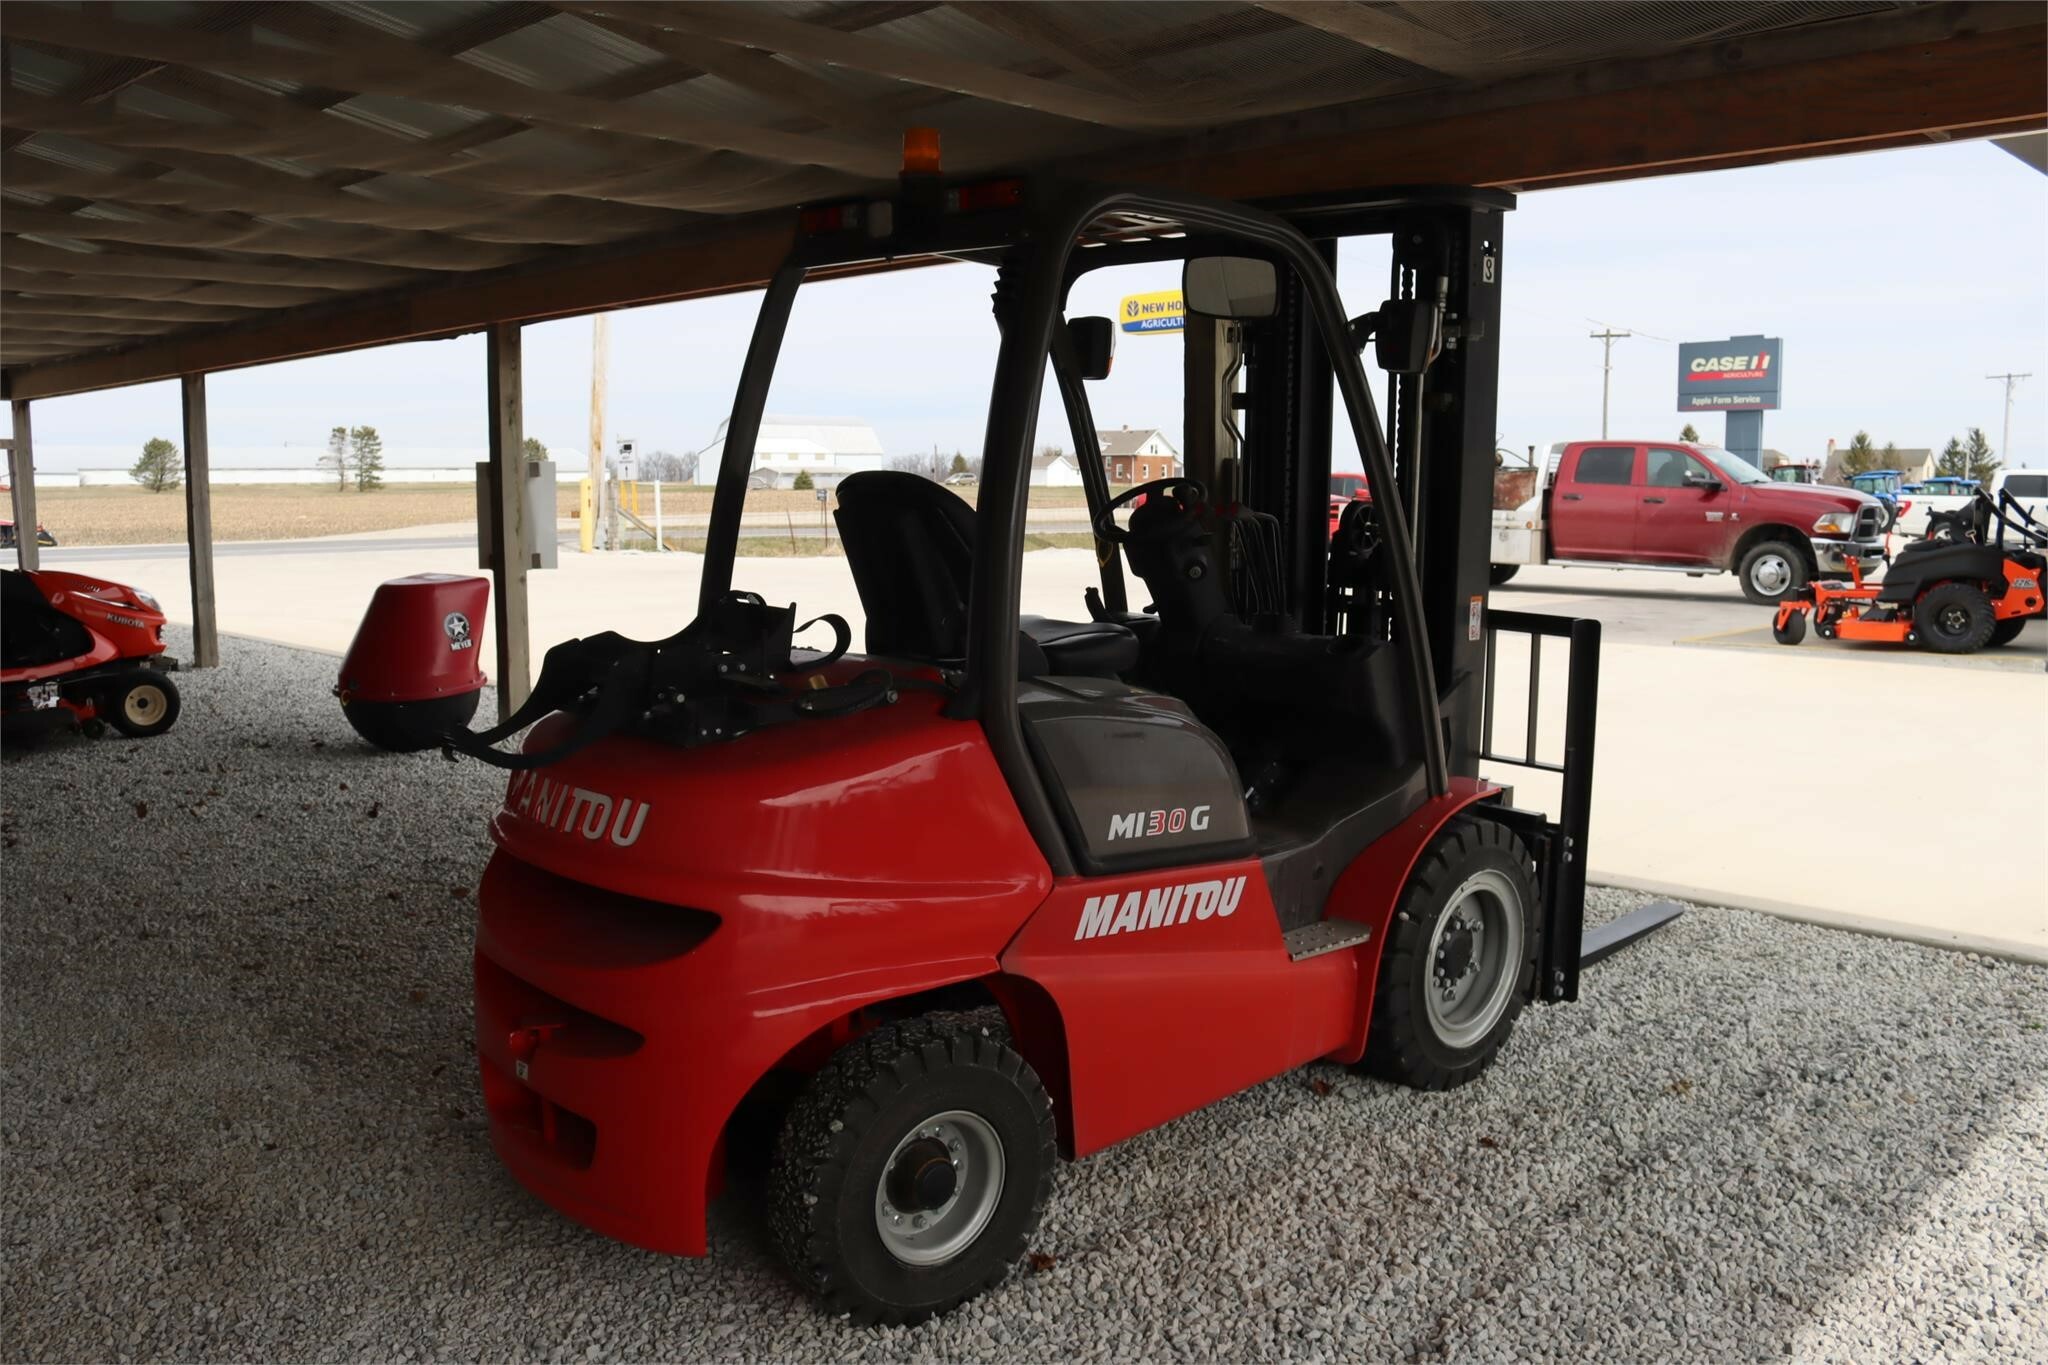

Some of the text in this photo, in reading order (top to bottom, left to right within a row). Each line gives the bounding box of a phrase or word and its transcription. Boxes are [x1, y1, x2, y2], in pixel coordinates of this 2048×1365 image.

[1142, 302, 1165, 314] NEW
[1690, 356, 1749, 372] CASE
[1691, 395, 1760, 407] Apple Farm Service
[106, 612, 145, 628] KUBOTA
[1074, 876, 1247, 941] MANITOU
